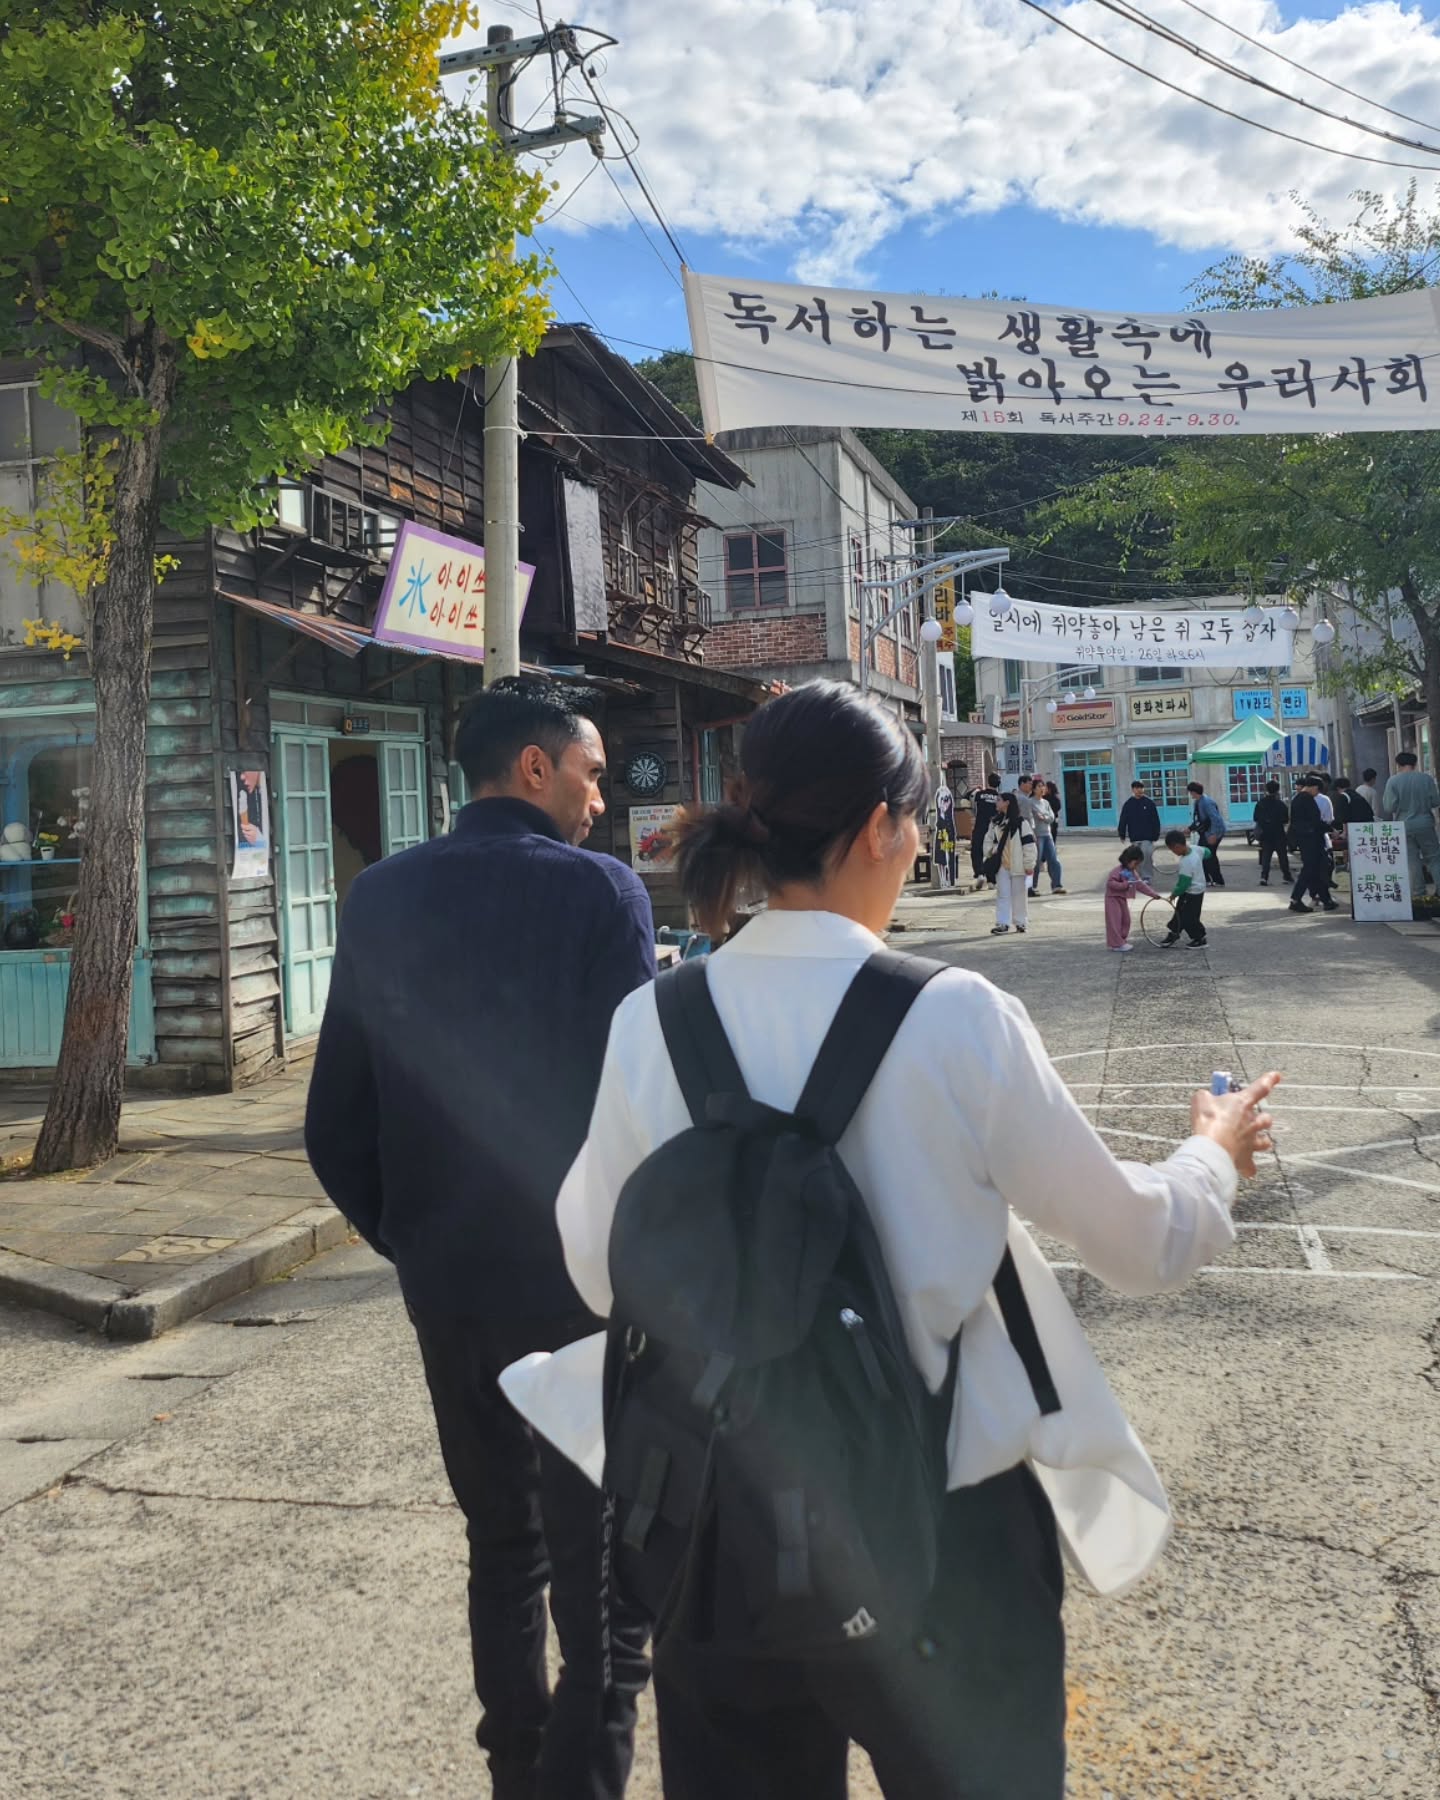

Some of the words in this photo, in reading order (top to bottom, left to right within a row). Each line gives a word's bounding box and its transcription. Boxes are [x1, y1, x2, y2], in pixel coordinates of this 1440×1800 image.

[723, 289, 956, 353] 독서하는
[997, 309, 1213, 360] 생활속에
[957, 357, 1182, 407] 밝아오는
[1217, 354, 1427, 411] 우리사회
[961, 410, 1024, 425] 제15회
[989, 604, 1042, 637] 일시에
[1052, 608, 1120, 641] 쥐약놓아
[1130, 614, 1165, 642] 남은
[1174, 615, 1190, 641] 쥐
[1200, 615, 1233, 643] 모두
[1133, 698, 1188, 715] 영화전파사
